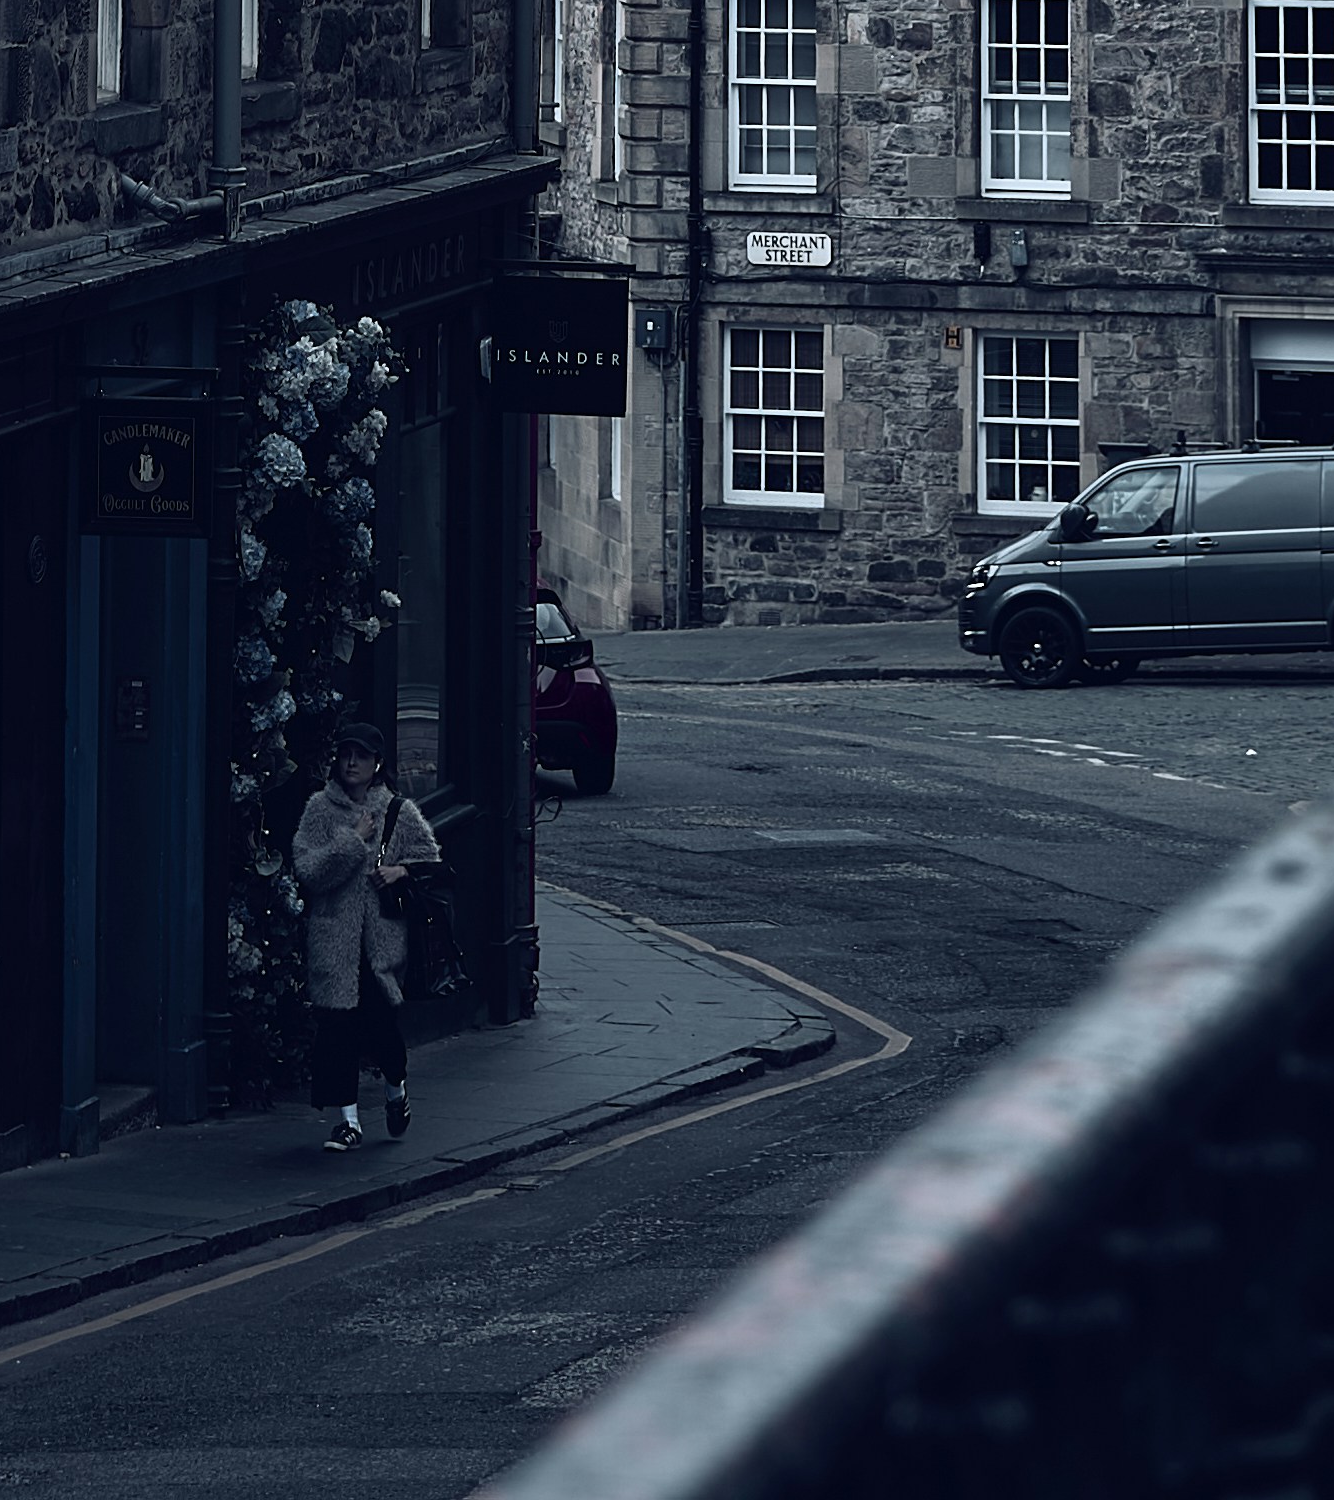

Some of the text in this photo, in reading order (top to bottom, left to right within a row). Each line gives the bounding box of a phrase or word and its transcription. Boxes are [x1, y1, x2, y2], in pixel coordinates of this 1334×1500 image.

[752, 235, 827, 249] MERCHANT
[765, 249, 813, 263] STREET
[353, 235, 466, 306] ISLANDER
[497, 348, 621, 366] ISLANDER
[103, 423, 192, 450] CANDLEMAKER
[150, 492, 191, 514] GOODS
